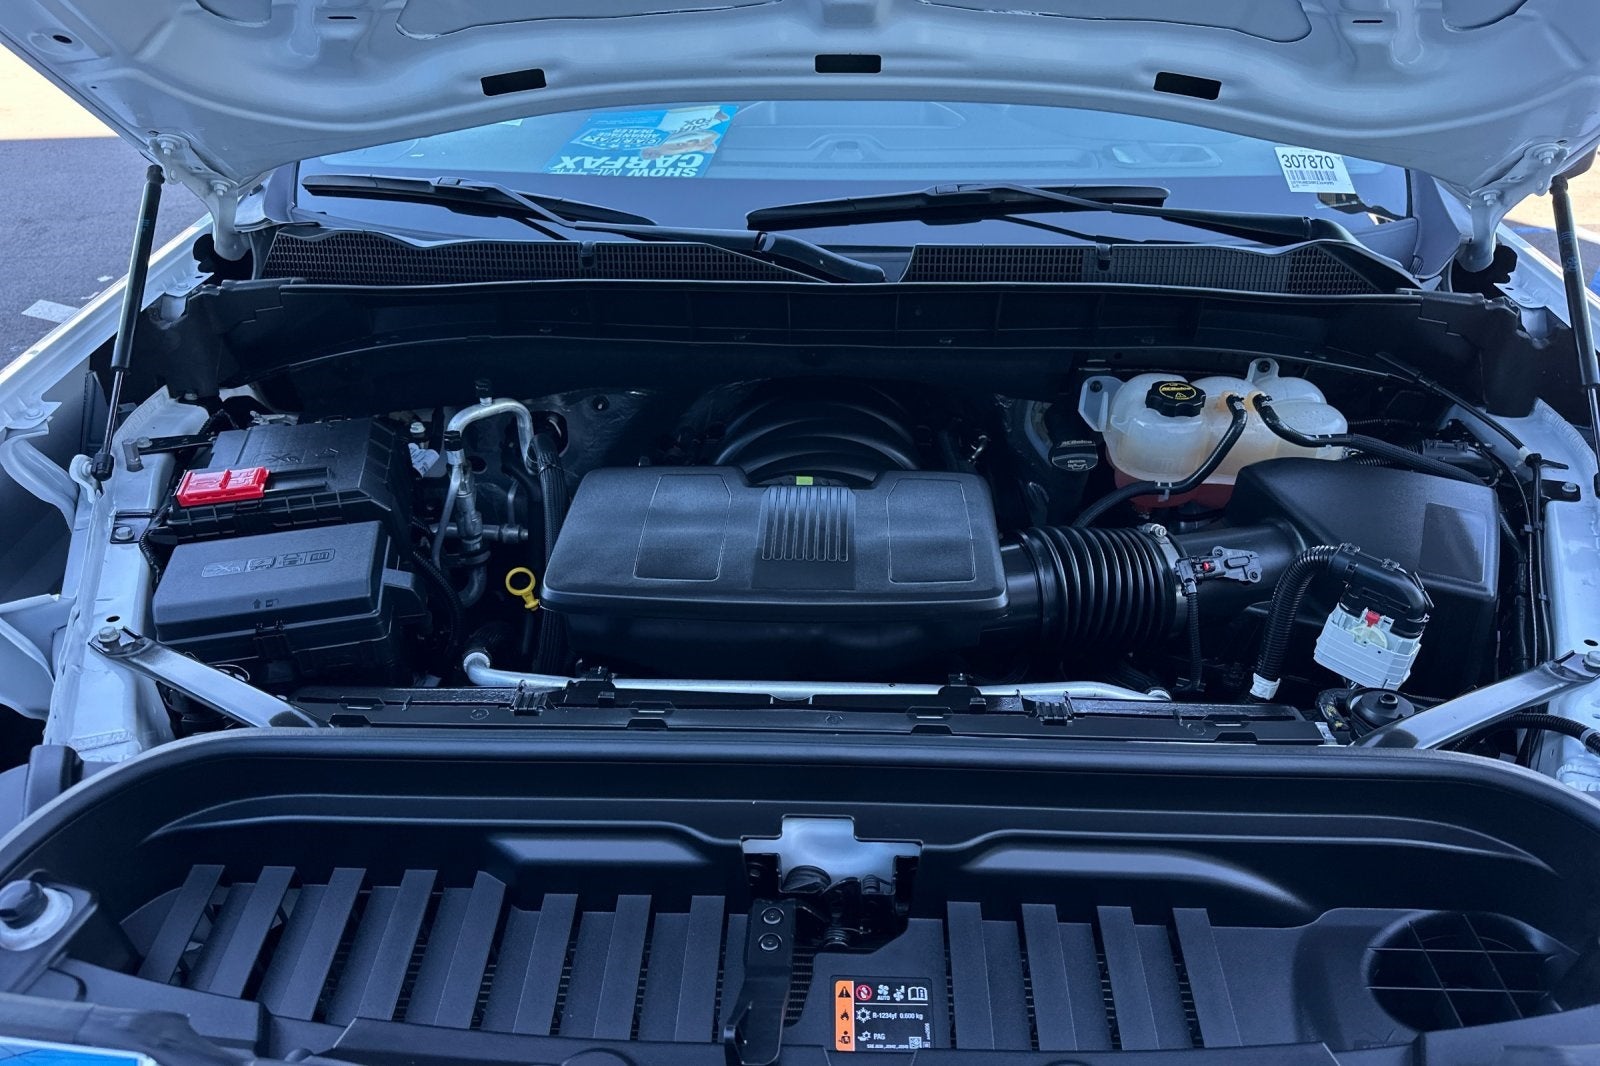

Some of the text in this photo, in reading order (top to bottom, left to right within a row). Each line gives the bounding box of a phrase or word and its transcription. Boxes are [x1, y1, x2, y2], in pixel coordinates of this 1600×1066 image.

[555, 154, 704, 169] CARFAX
[1281, 154, 1334, 169] 307870
[627, 167, 699, 177] SHOW
